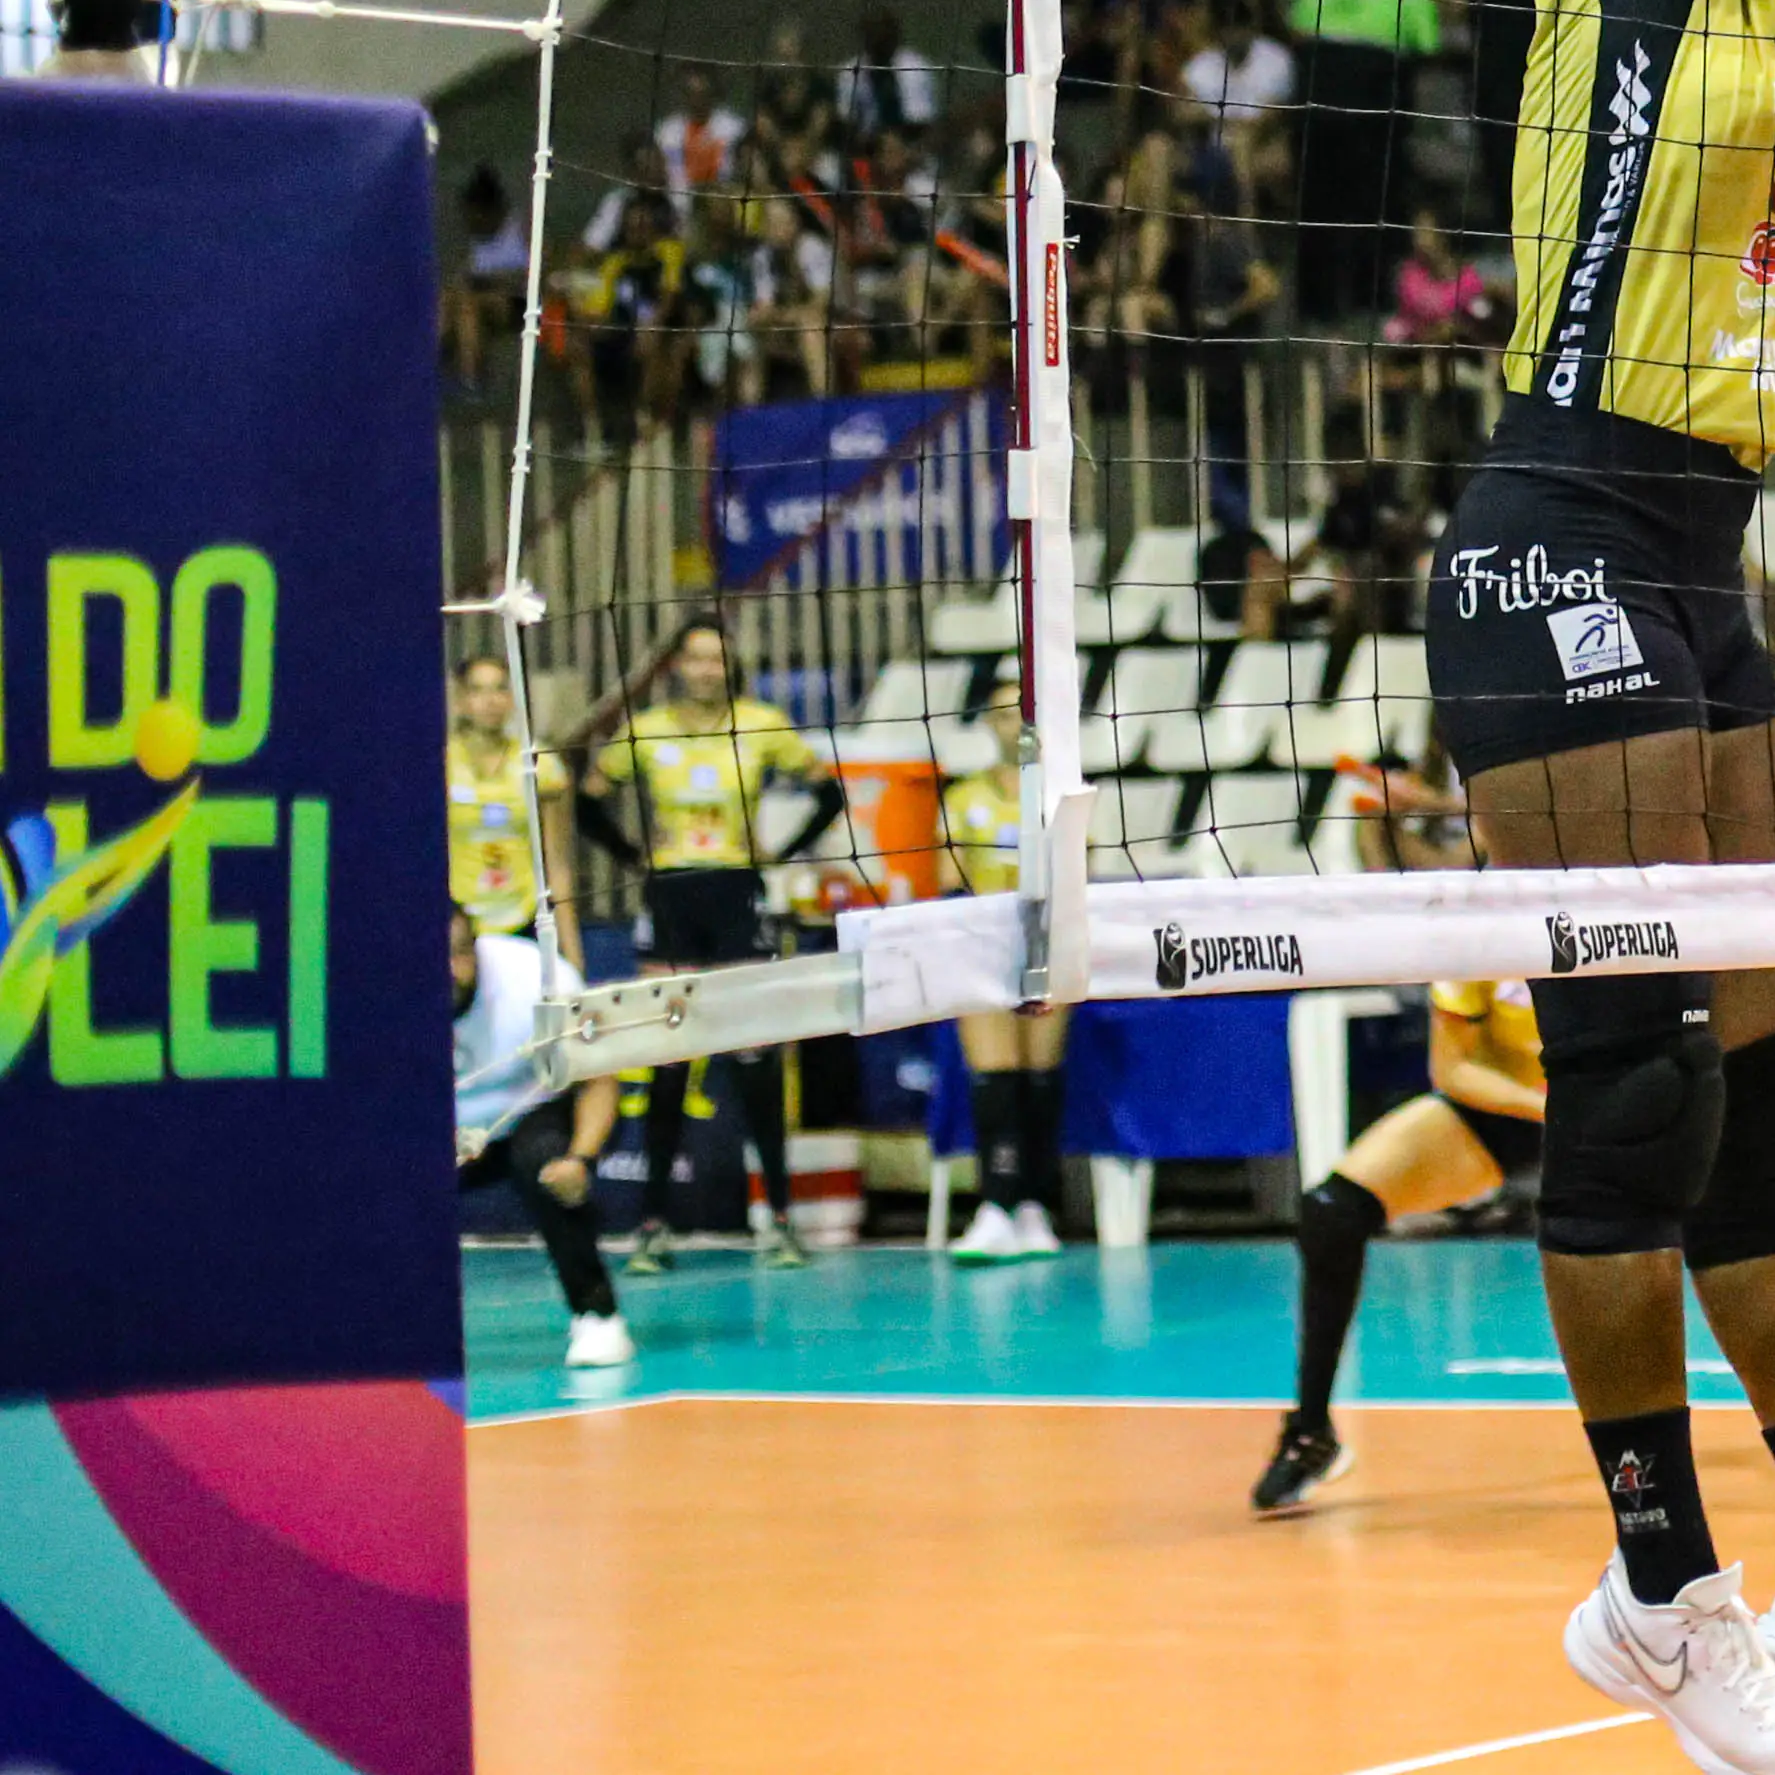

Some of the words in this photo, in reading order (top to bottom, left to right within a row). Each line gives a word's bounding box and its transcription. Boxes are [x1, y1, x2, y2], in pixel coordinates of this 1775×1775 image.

[1450, 544, 1617, 619] Friboi
[47, 544, 277, 770] DO
[1191, 934, 1304, 981] SUPERLIGA
[1579, 920, 1681, 966] SUPERLIGA
